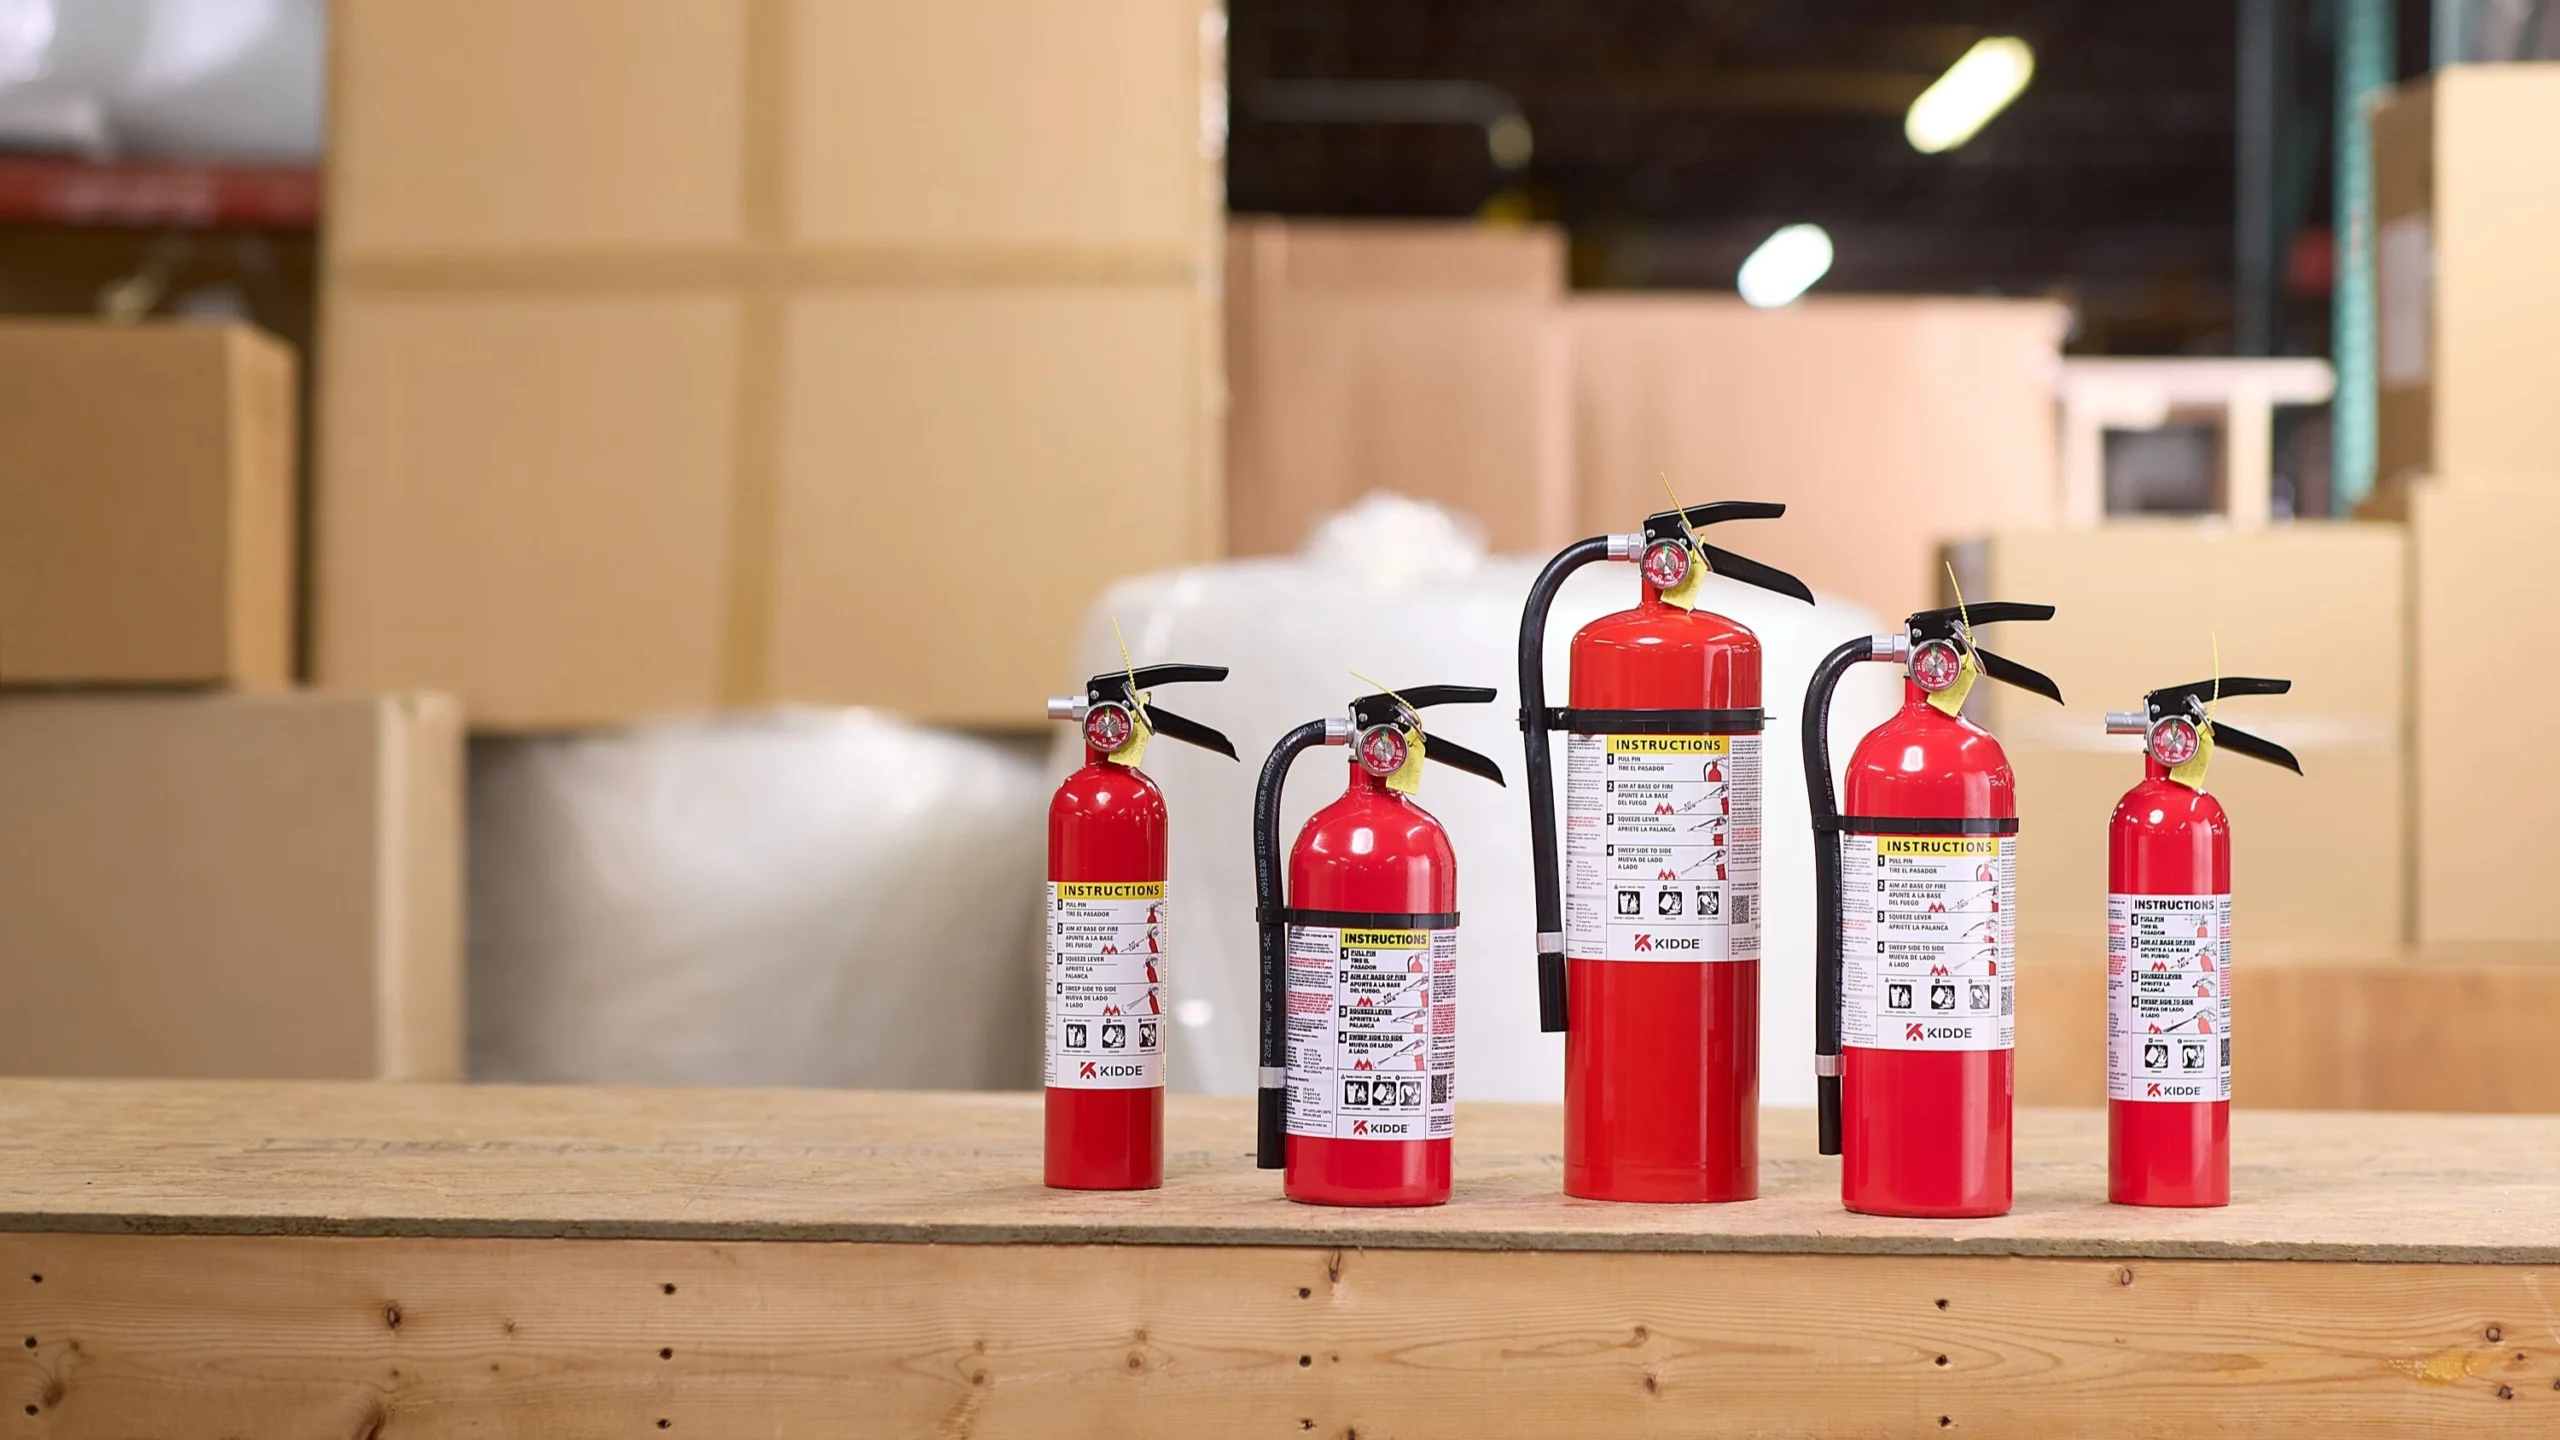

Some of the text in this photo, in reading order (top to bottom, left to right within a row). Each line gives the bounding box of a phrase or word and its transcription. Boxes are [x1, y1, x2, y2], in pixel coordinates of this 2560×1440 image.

[1616, 740, 1721, 750] INSTRUCTIONS
[1887, 842, 1991, 852] INSTRUCTIONS
[1064, 886, 1160, 896] INSTRUCTIONS
[2134, 900, 2214, 909] INSTRUCTIONS
[1345, 933, 1426, 944] INSTRUCTIONS
[1655, 939, 1700, 949] KIDDE
[1927, 1028, 1972, 1038] KIDDE
[1100, 1066, 1143, 1076] KIDDE
[2164, 1087, 2200, 1095] KIDDE
[1371, 1124, 1407, 1133] KIDDE
